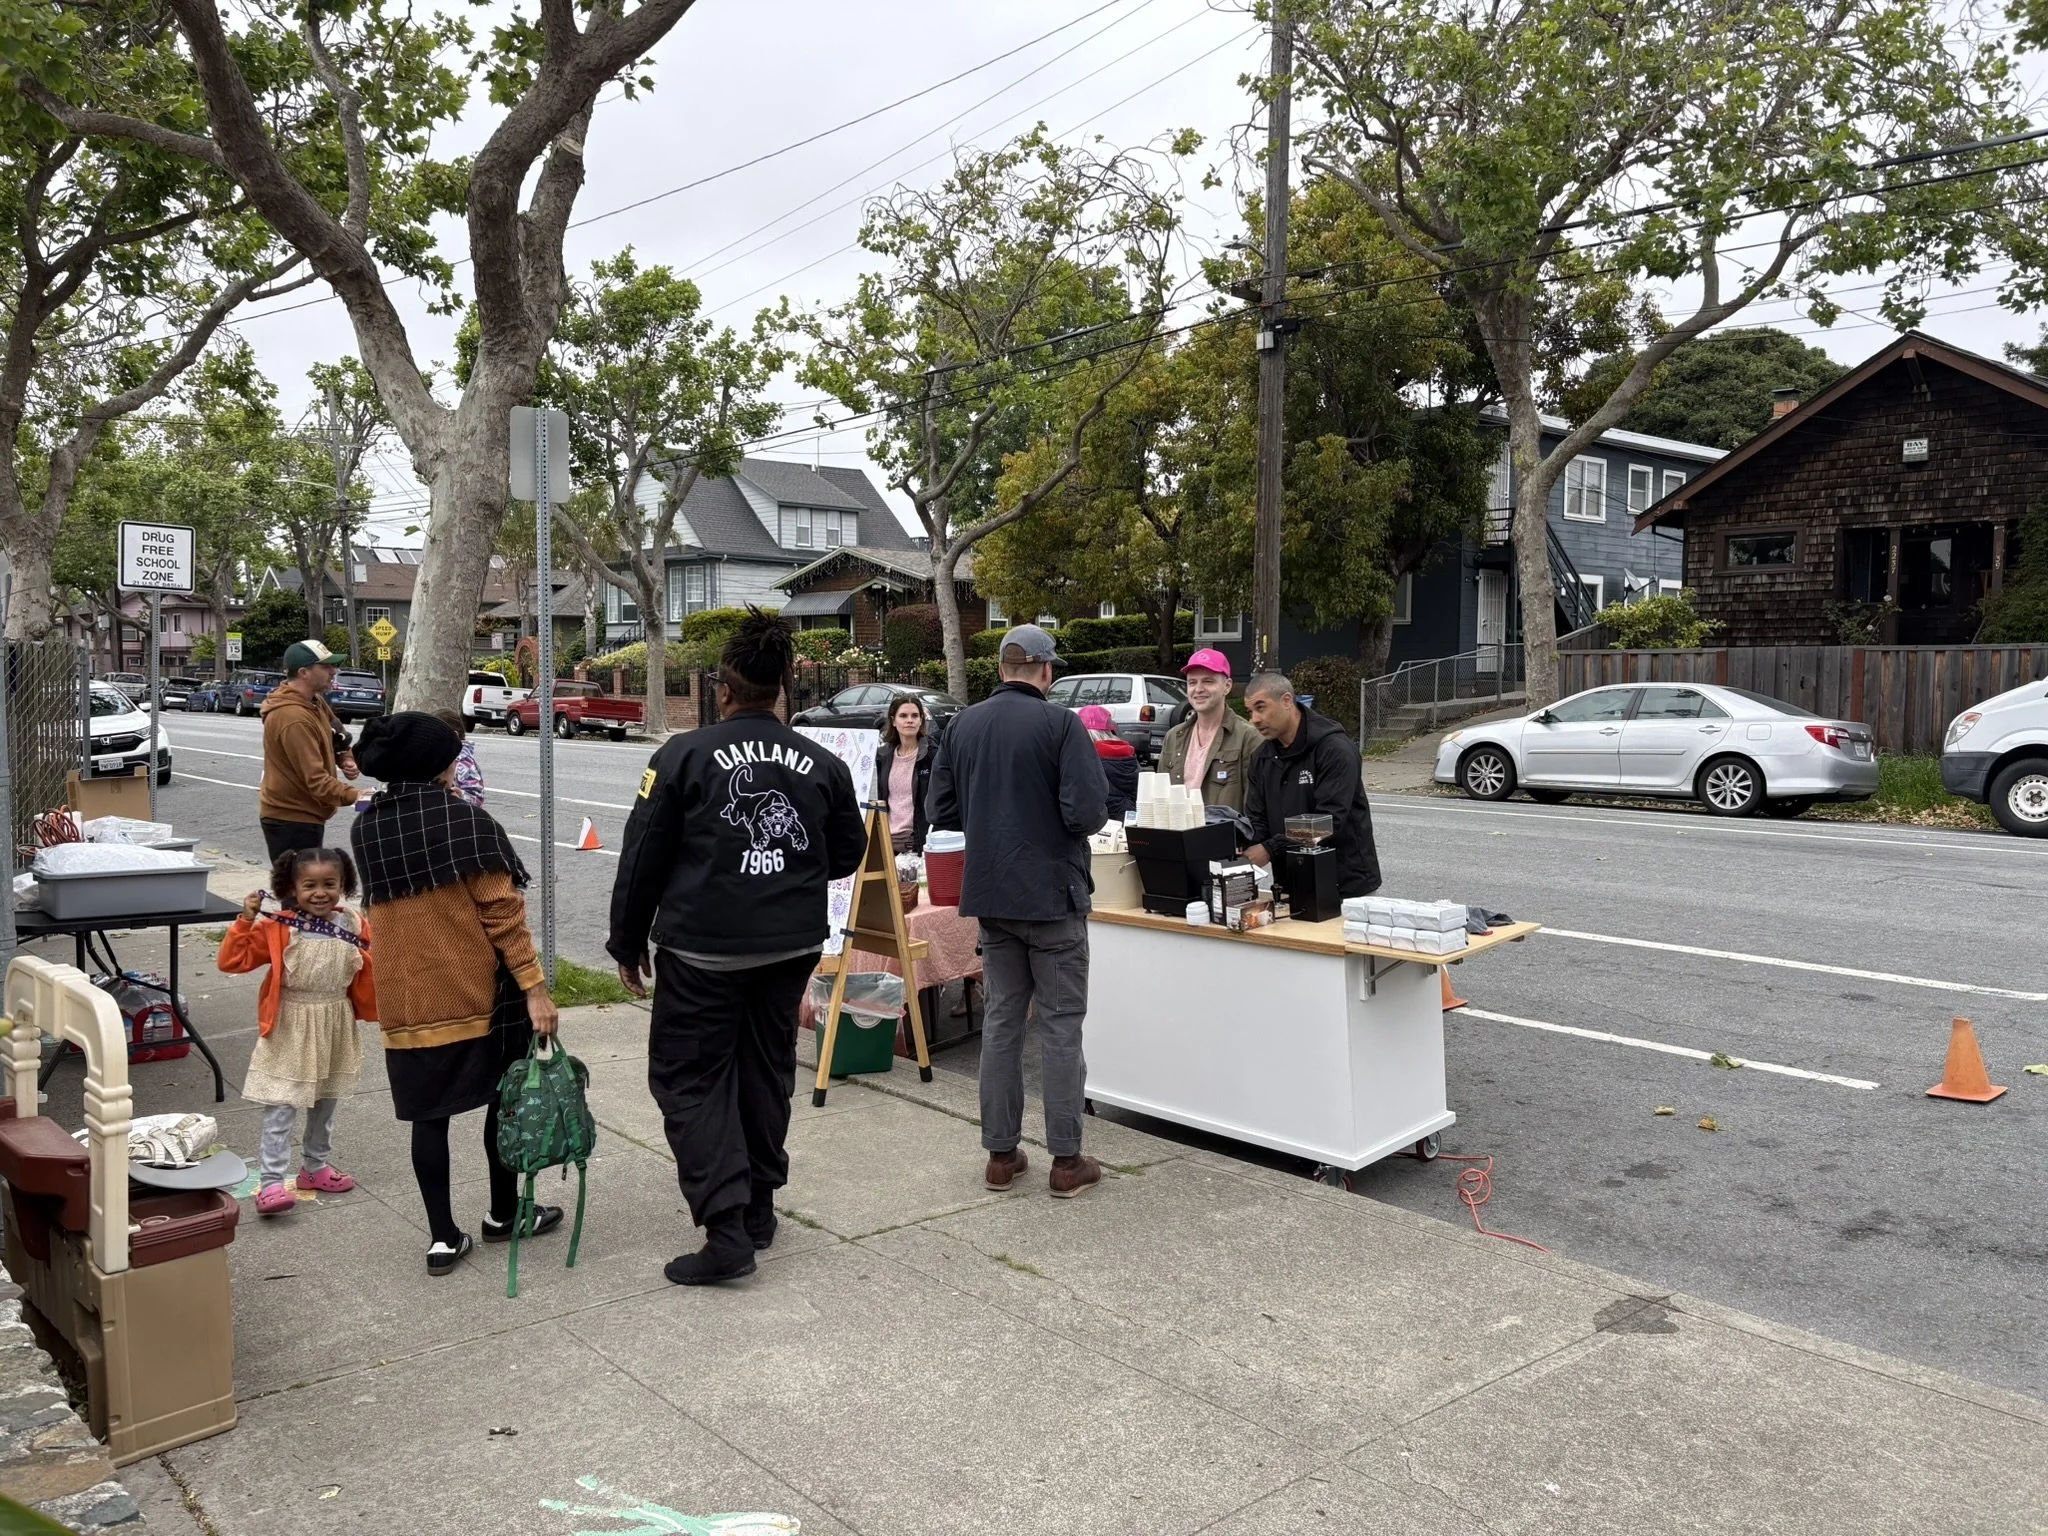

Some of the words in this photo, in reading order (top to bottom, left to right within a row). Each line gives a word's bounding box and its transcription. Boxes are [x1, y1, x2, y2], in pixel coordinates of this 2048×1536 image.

[142, 531, 174, 543] DRUG
[142, 545, 174, 556] FREE
[136, 557, 180, 569] SCHOOL
[142, 570, 174, 582] ZONE
[714, 741, 814, 775] OAKLAND
[740, 848, 785, 875] 1966
